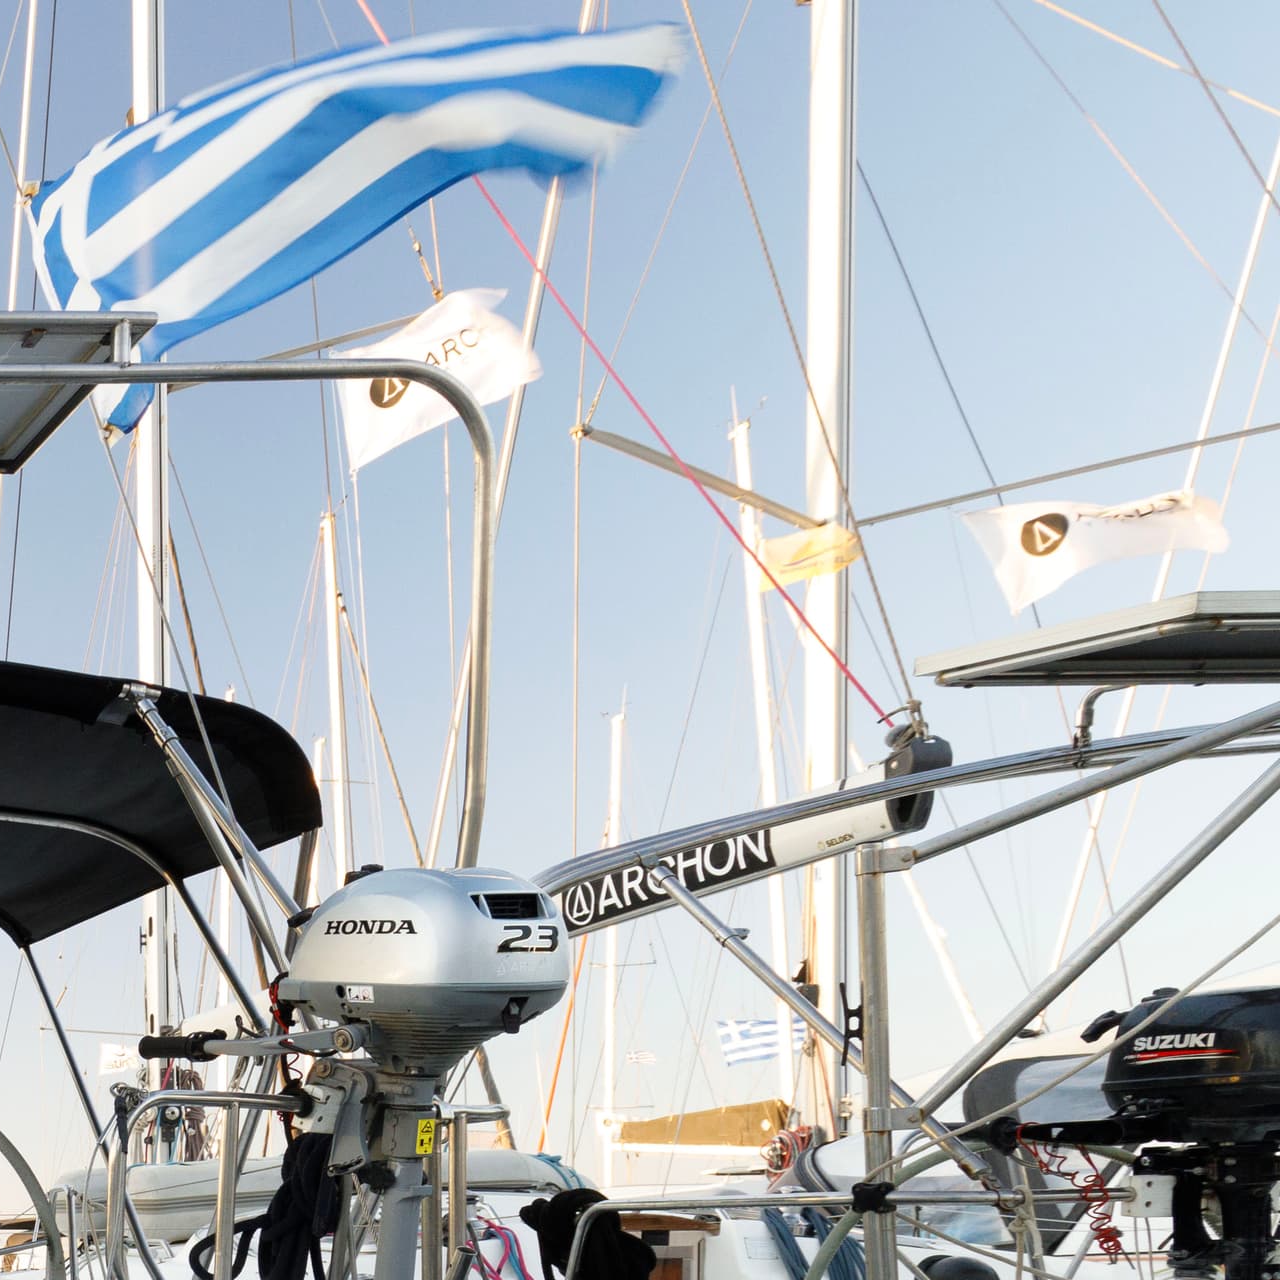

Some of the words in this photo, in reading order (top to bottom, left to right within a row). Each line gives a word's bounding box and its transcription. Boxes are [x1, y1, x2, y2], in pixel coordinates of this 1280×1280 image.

[425, 328, 479, 367] ARC
[598, 829, 768, 916] ARCHON
[324, 919, 418, 935] HONDA
[1133, 1032, 1216, 1052] SUZUKI
